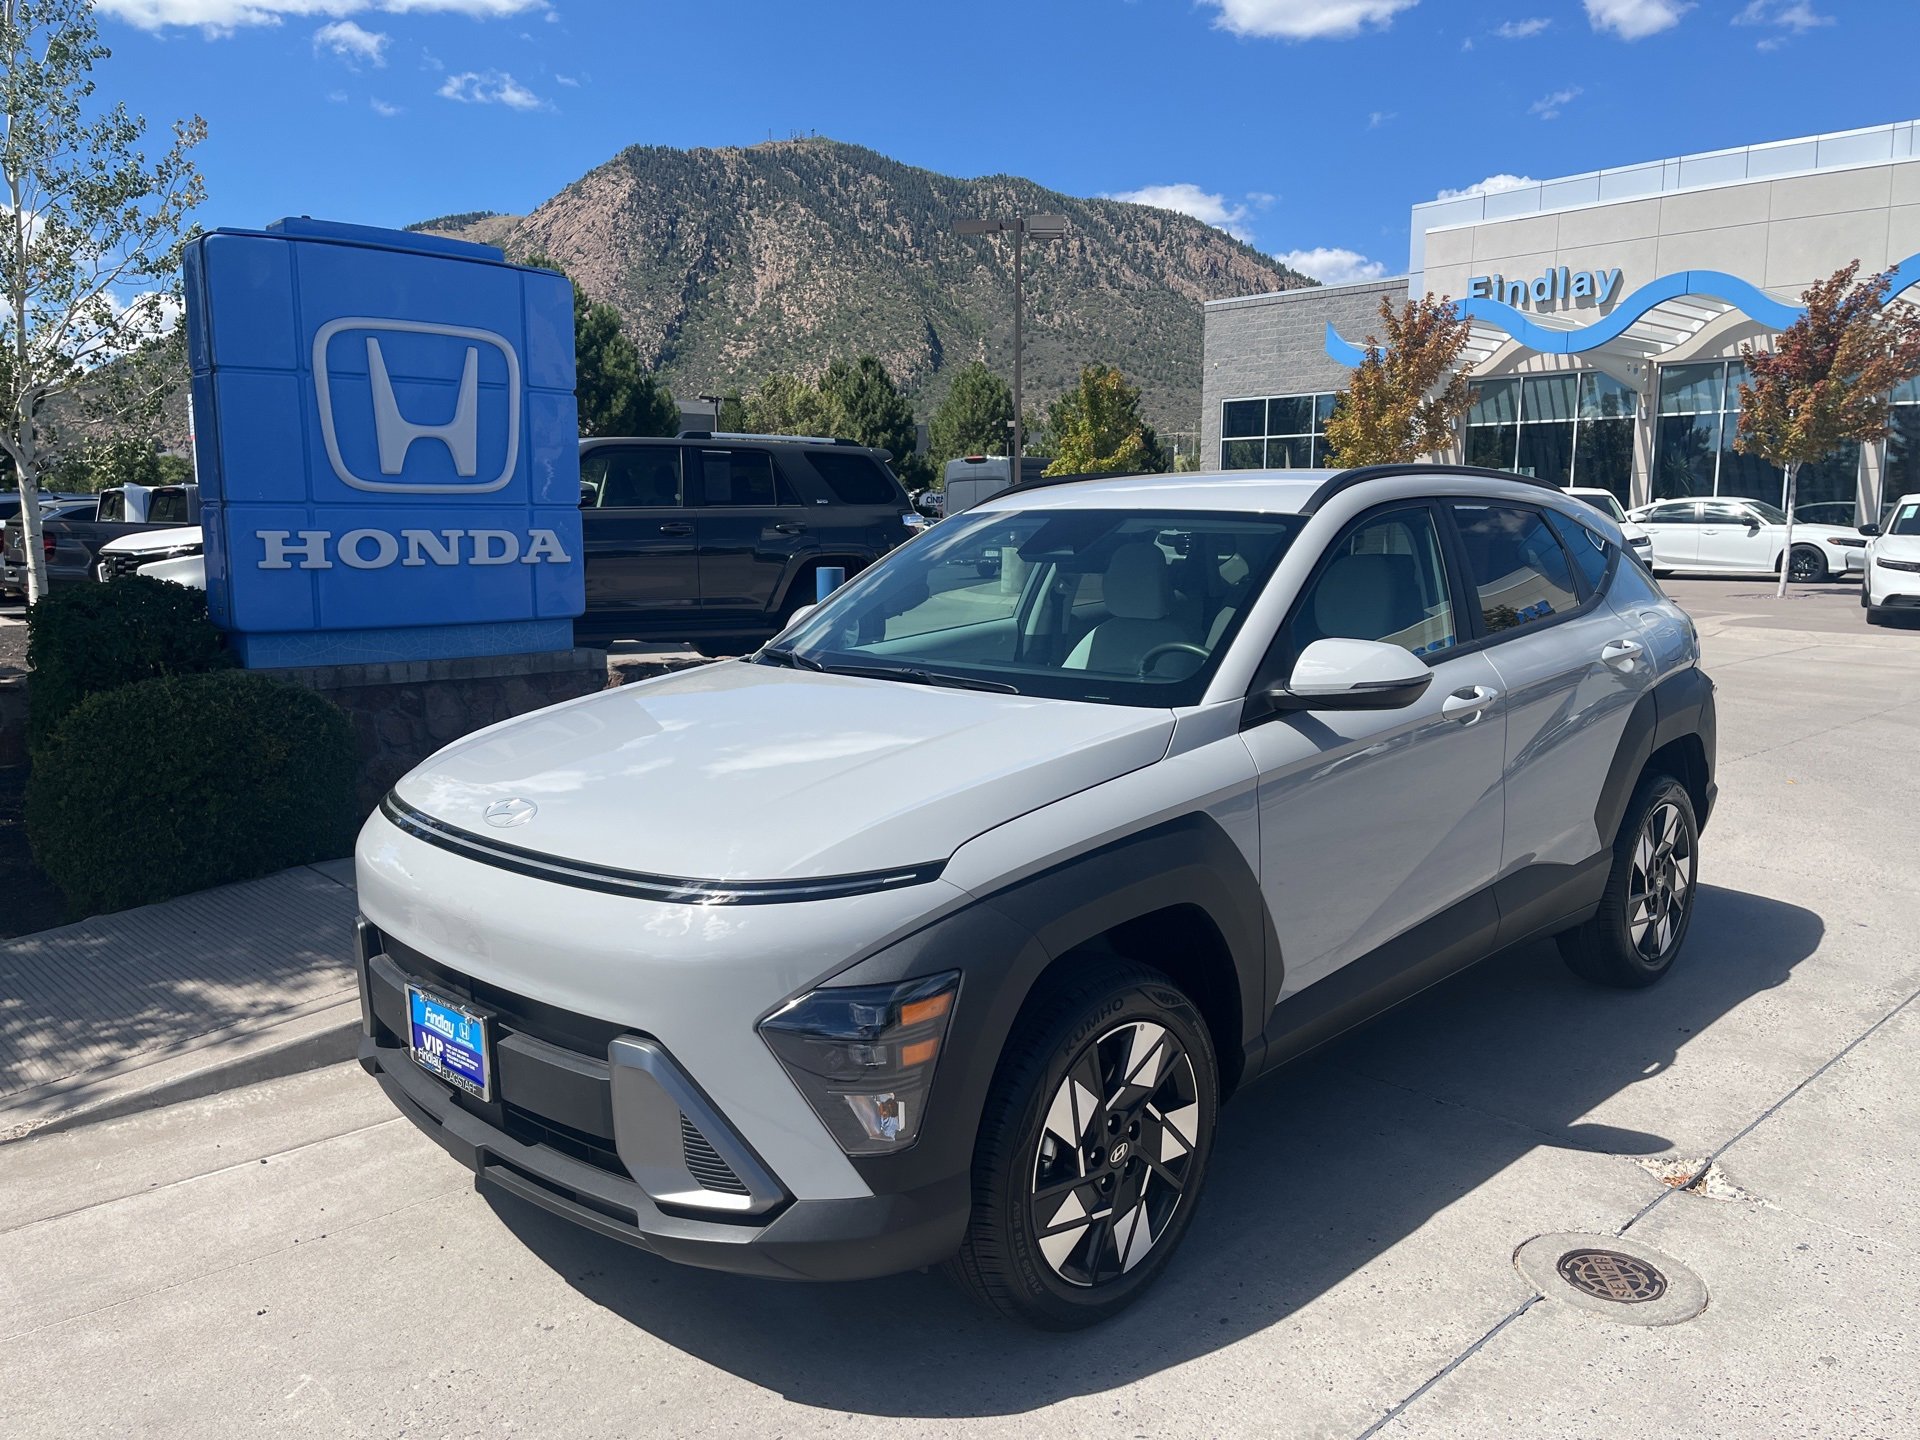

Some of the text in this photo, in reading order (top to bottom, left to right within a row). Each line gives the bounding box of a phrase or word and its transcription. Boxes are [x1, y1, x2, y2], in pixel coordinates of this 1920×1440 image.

[1467, 266, 1622, 305] Findlay
[256, 528, 572, 570] HONDA
[425, 1006, 455, 1039] Findlay
[1062, 997, 1124, 1056] KUMHO
[422, 1031, 444, 1057] VIP
[442, 1066, 477, 1093] FLAGSTAFF
[1594, 1257, 1632, 1298] SEWER
